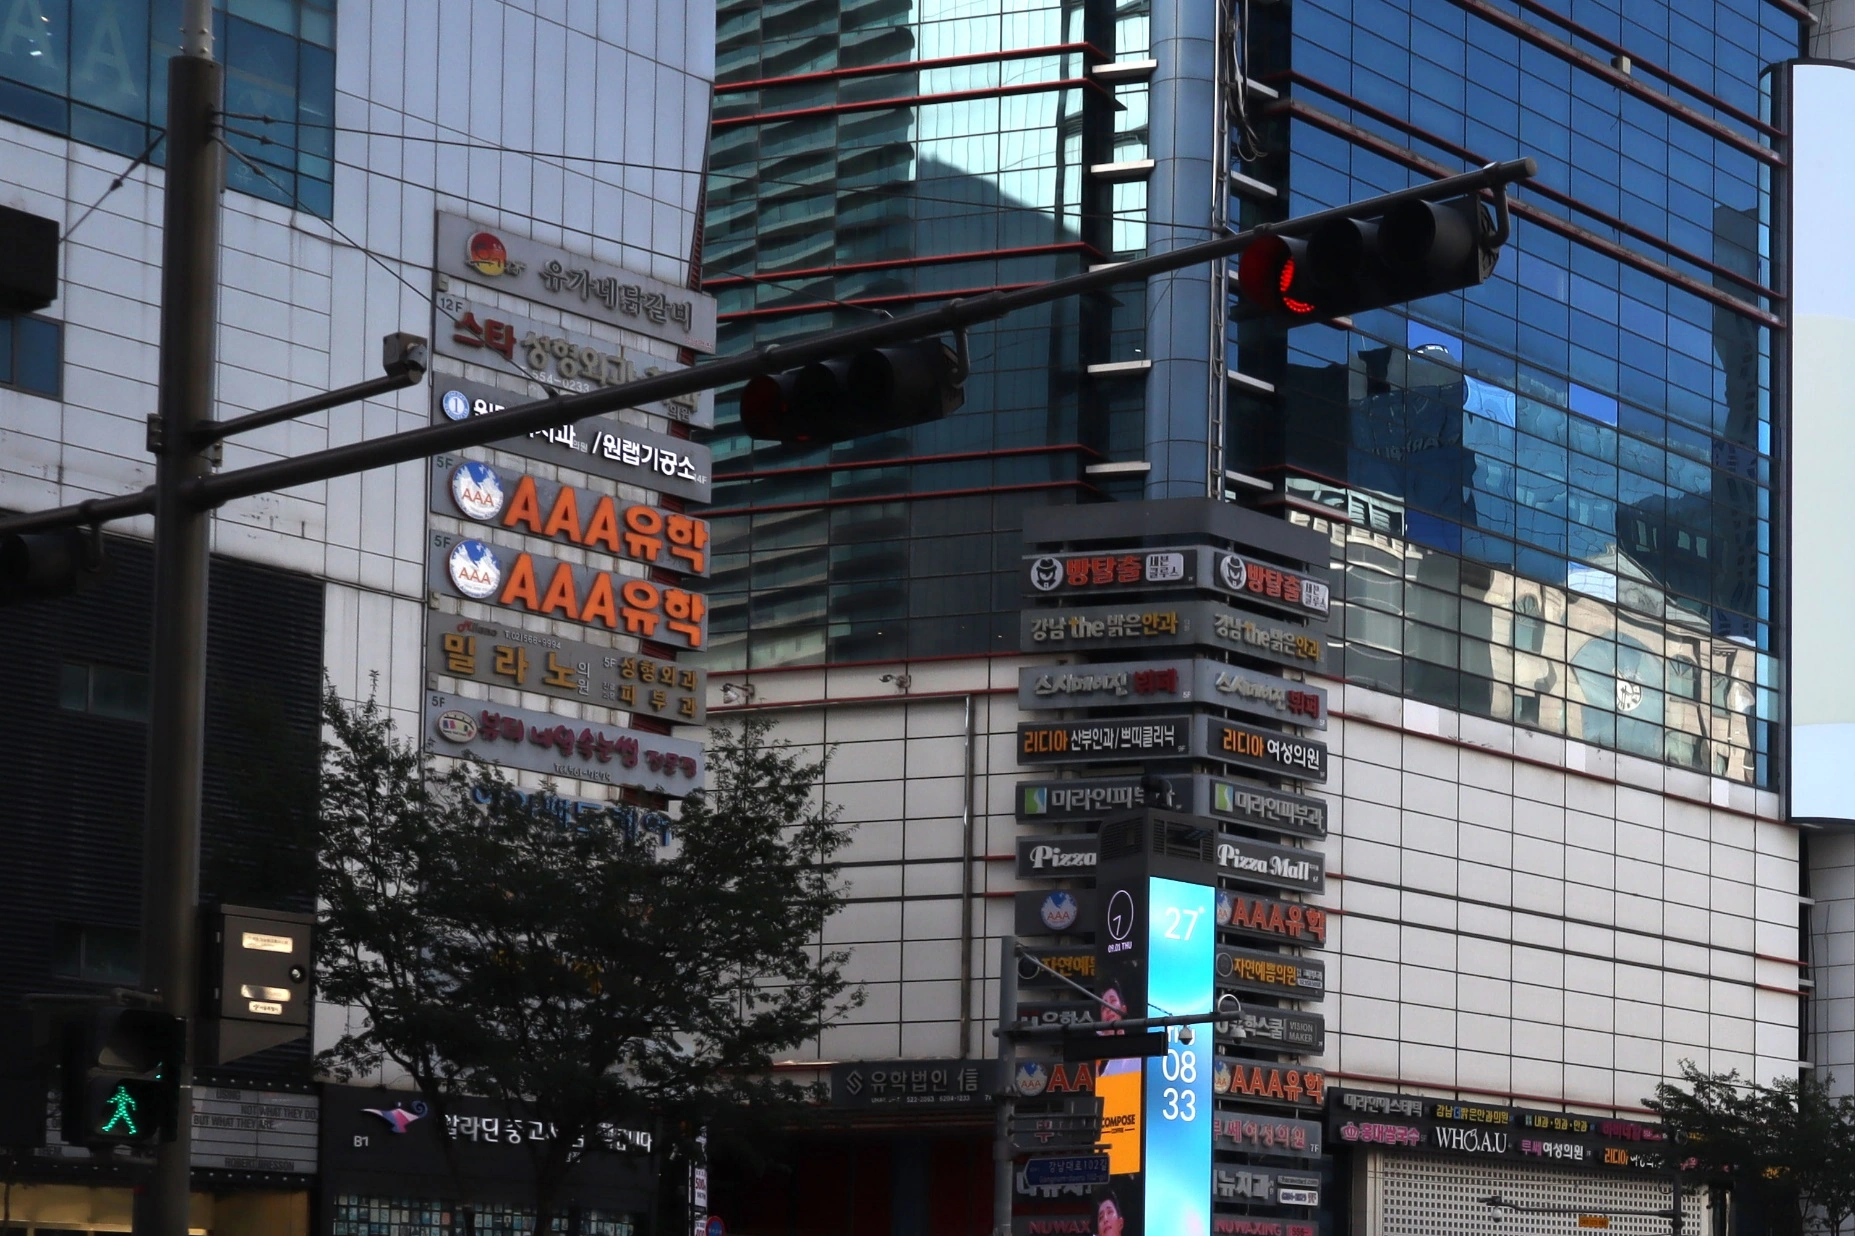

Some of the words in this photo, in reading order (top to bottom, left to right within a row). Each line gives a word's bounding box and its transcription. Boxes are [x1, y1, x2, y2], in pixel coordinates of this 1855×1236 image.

[540, 260, 692, 331] 유가네닭갈비
[454, 312, 516, 359] 스타
[521, 331, 641, 386] 성형외과
[462, 490, 495, 507] AAA
[503, 475, 709, 574] AAA유학
[458, 568, 491, 585] AAA
[499, 552, 706, 648] AAA유학
[1031, 617, 1067, 642] 강남
[1068, 616, 1105, 640] the
[1215, 612, 1242, 641] 강남
[620, 656, 698, 692] 성형외과
[618, 684, 698, 718] 피부과
[1024, 729, 1069, 753] 리디아
[1223, 728, 1265, 758] 리디아
[1267, 739, 1320, 771] 여성의원
[1234, 790, 1323, 831] 미라인피부과
[1030, 845, 1097, 869] Pizza
[1217, 843, 1267, 873] Pizza
[1269, 855, 1309, 881] Mall
[1047, 911, 1070, 921] AAA
[1232, 896, 1326, 943] AAA유학
[1289, 1021, 1313, 1032] VISION
[1289, 1032, 1313, 1043] MAKER
[1162, 1048, 1197, 1083] 08
[871, 1069, 948, 1093] 유학법인
[957, 1068, 979, 1092] 信
[1021, 1080, 1041, 1088] AAA
[1230, 1064, 1323, 1105] AAA유학
[1162, 1087, 1196, 1122] 33
[193, 1115, 209, 1125] BUT
[354, 1136, 369, 1148] B1
[1359, 1122, 1420, 1146] 홍대쌀국수
[1048, 1159, 1108, 1174] 강남대로102길
[1215, 1220, 1281, 1236] NUWAXING
